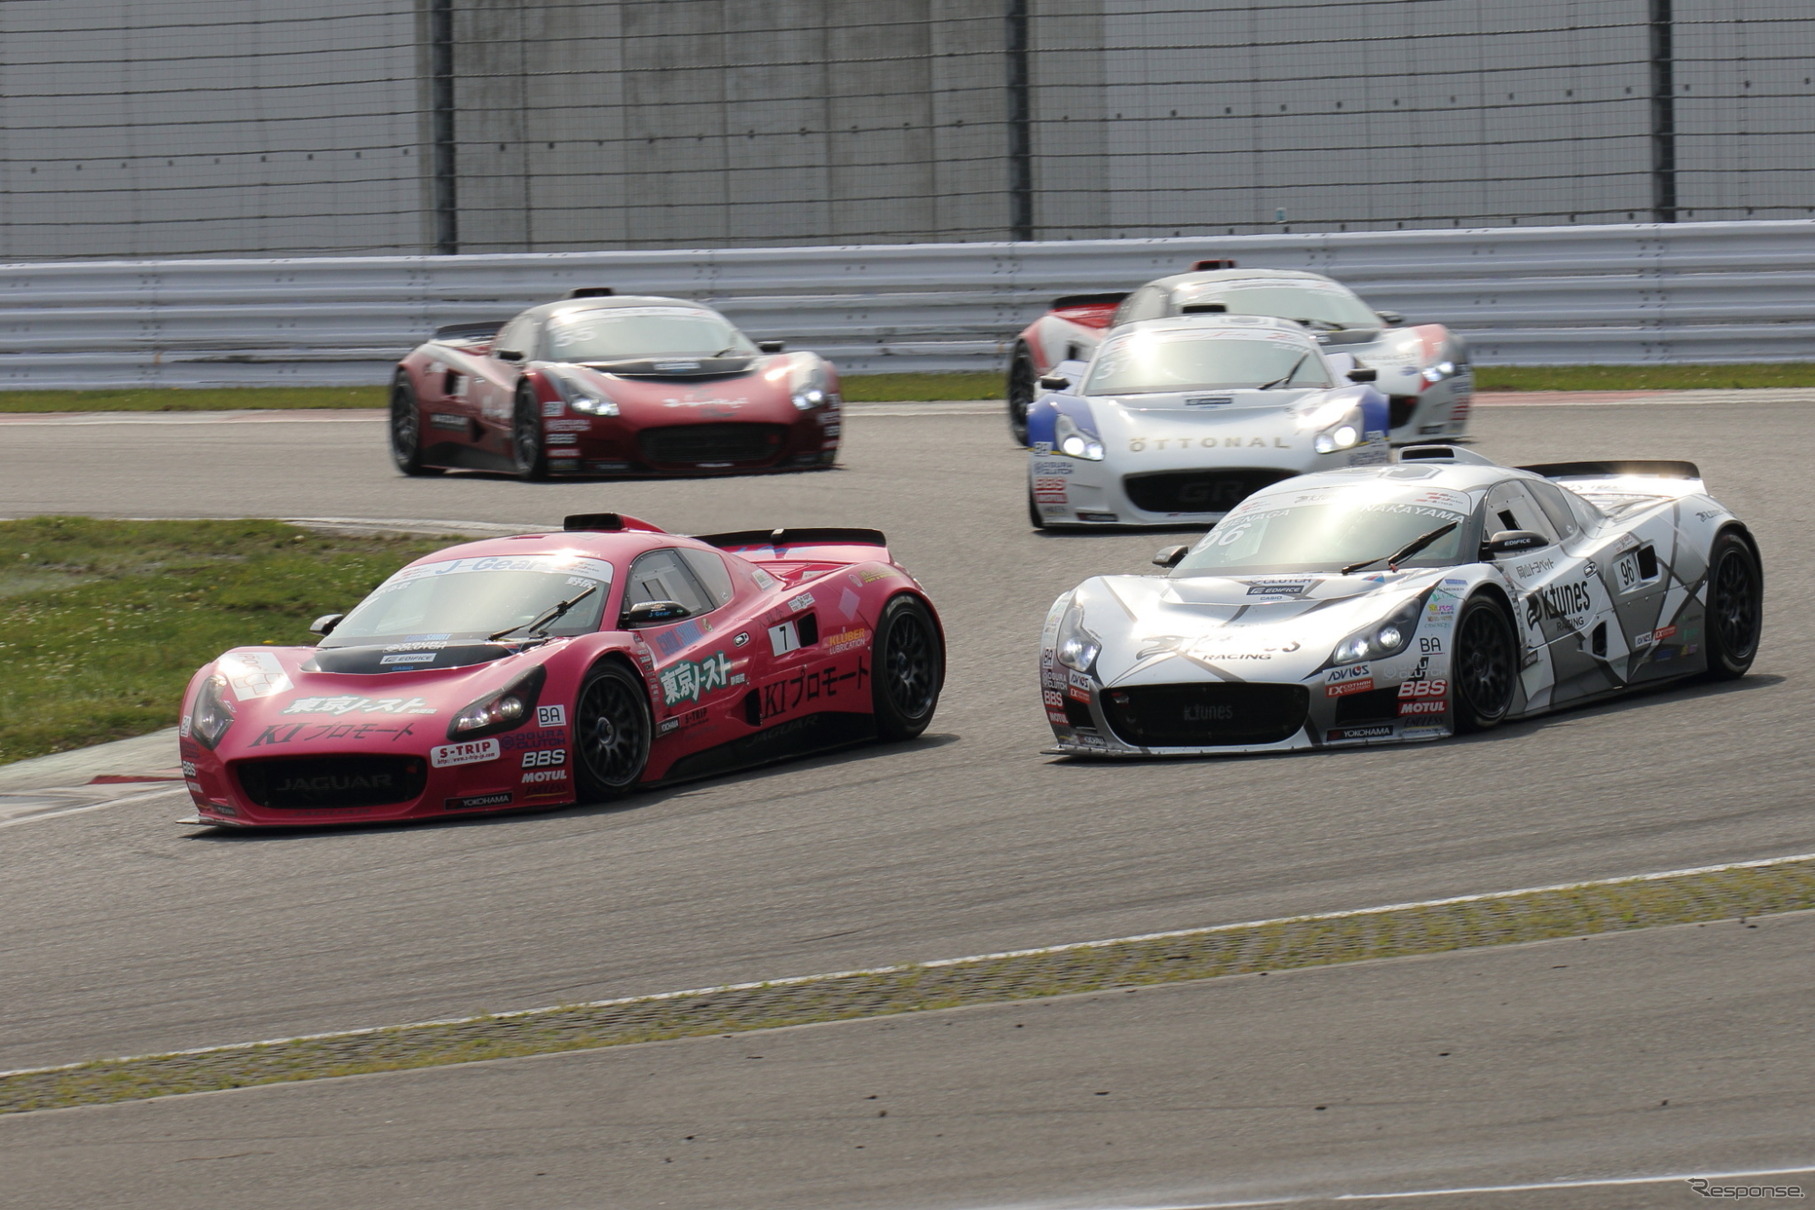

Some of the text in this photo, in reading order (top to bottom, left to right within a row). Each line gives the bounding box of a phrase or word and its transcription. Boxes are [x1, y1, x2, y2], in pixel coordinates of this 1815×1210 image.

[1361, 504, 1466, 524] NAKAYAMA
[1191, 523, 1252, 556] 96
[435, 557, 544, 575] J-Gear
[1620, 558, 1635, 586] 96
[779, 625, 788, 651] 7
[1419, 636, 1442, 652] BA
[1397, 679, 1447, 698] BBS
[1043, 690, 1063, 707] BBS
[1400, 701, 1445, 713] MOTUL
[538, 706, 561, 723] BA
[1343, 727, 1391, 738] YOKOHAMA
[440, 742, 491, 758] S-TRIP
[521, 748, 567, 768] BBS
[275, 773, 394, 791] JAGUAR
[521, 770, 567, 784] MOTUL
[462, 795, 510, 806] YOKOHAMA
